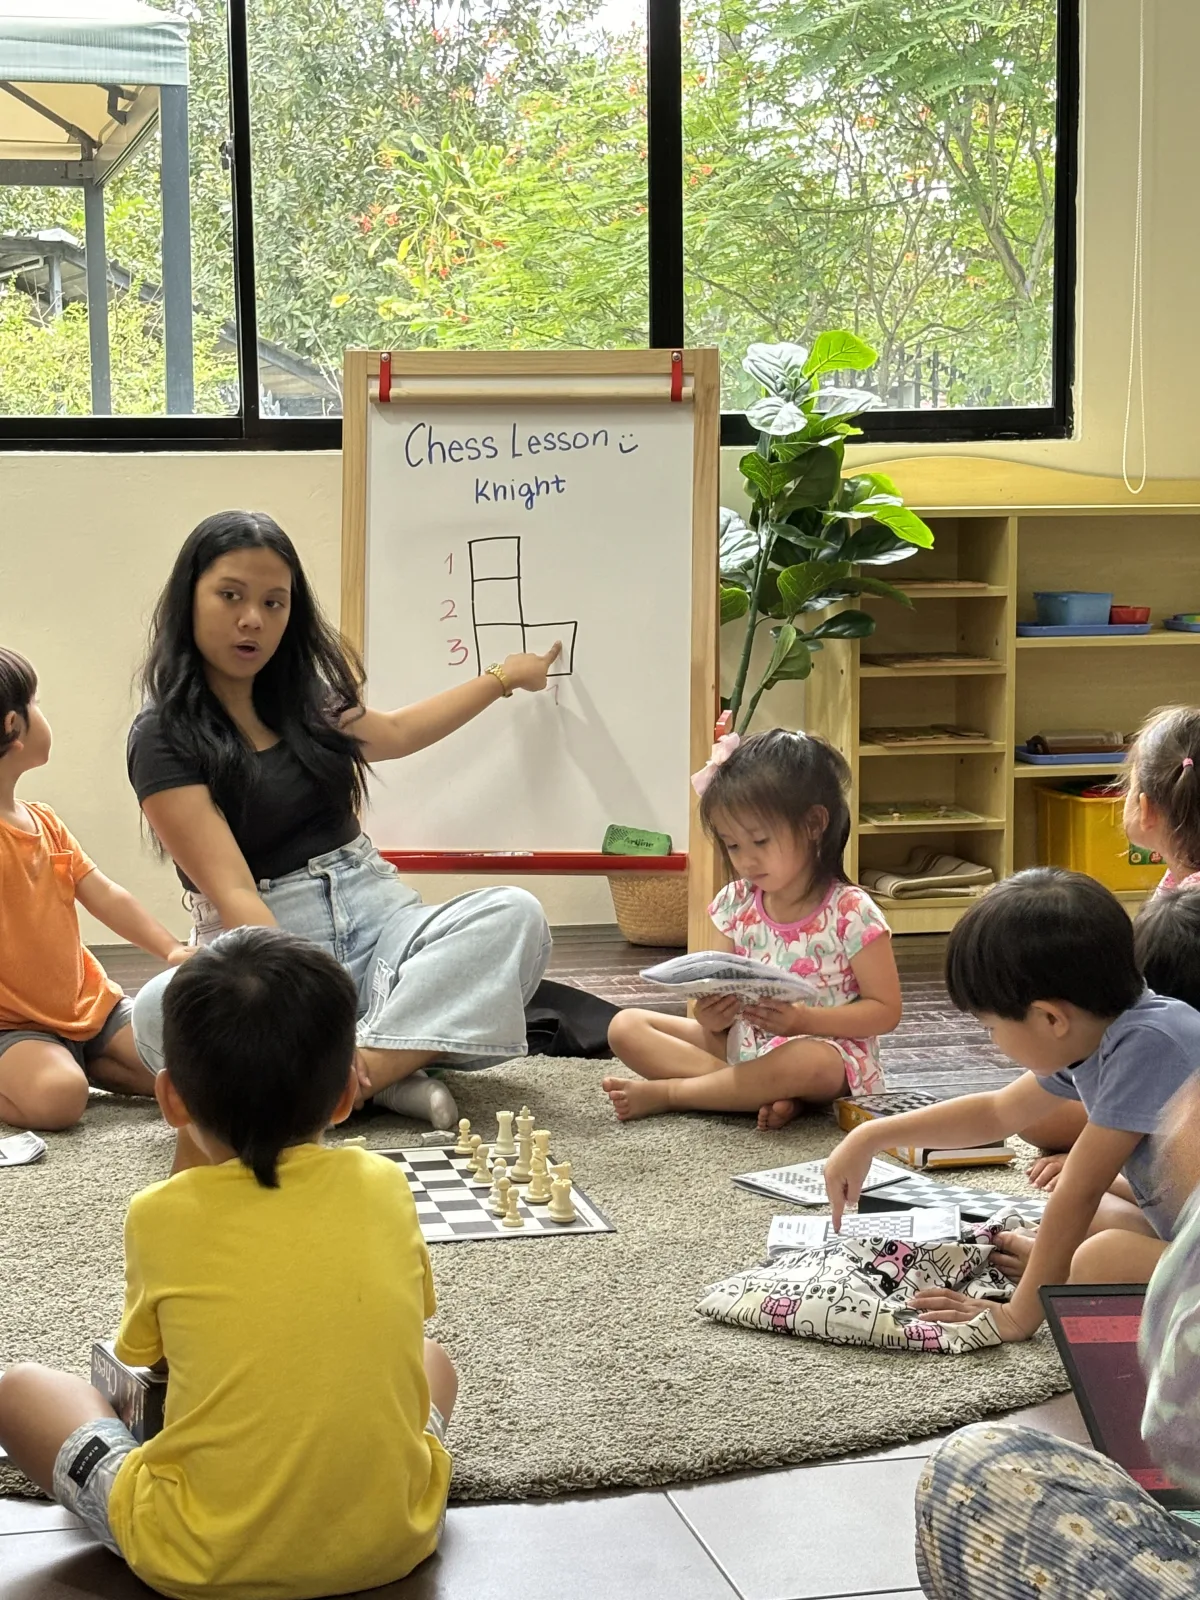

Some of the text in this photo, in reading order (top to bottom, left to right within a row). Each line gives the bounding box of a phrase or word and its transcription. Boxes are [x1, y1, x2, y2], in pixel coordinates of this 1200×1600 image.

[405, 422, 608, 467] Chess Lesson
[475, 474, 566, 510] Knight
[444, 552, 453, 575] 1
[439, 599, 458, 621] 2
[447, 638, 469, 666] 3
[94, 1351, 118, 1396] Chess
